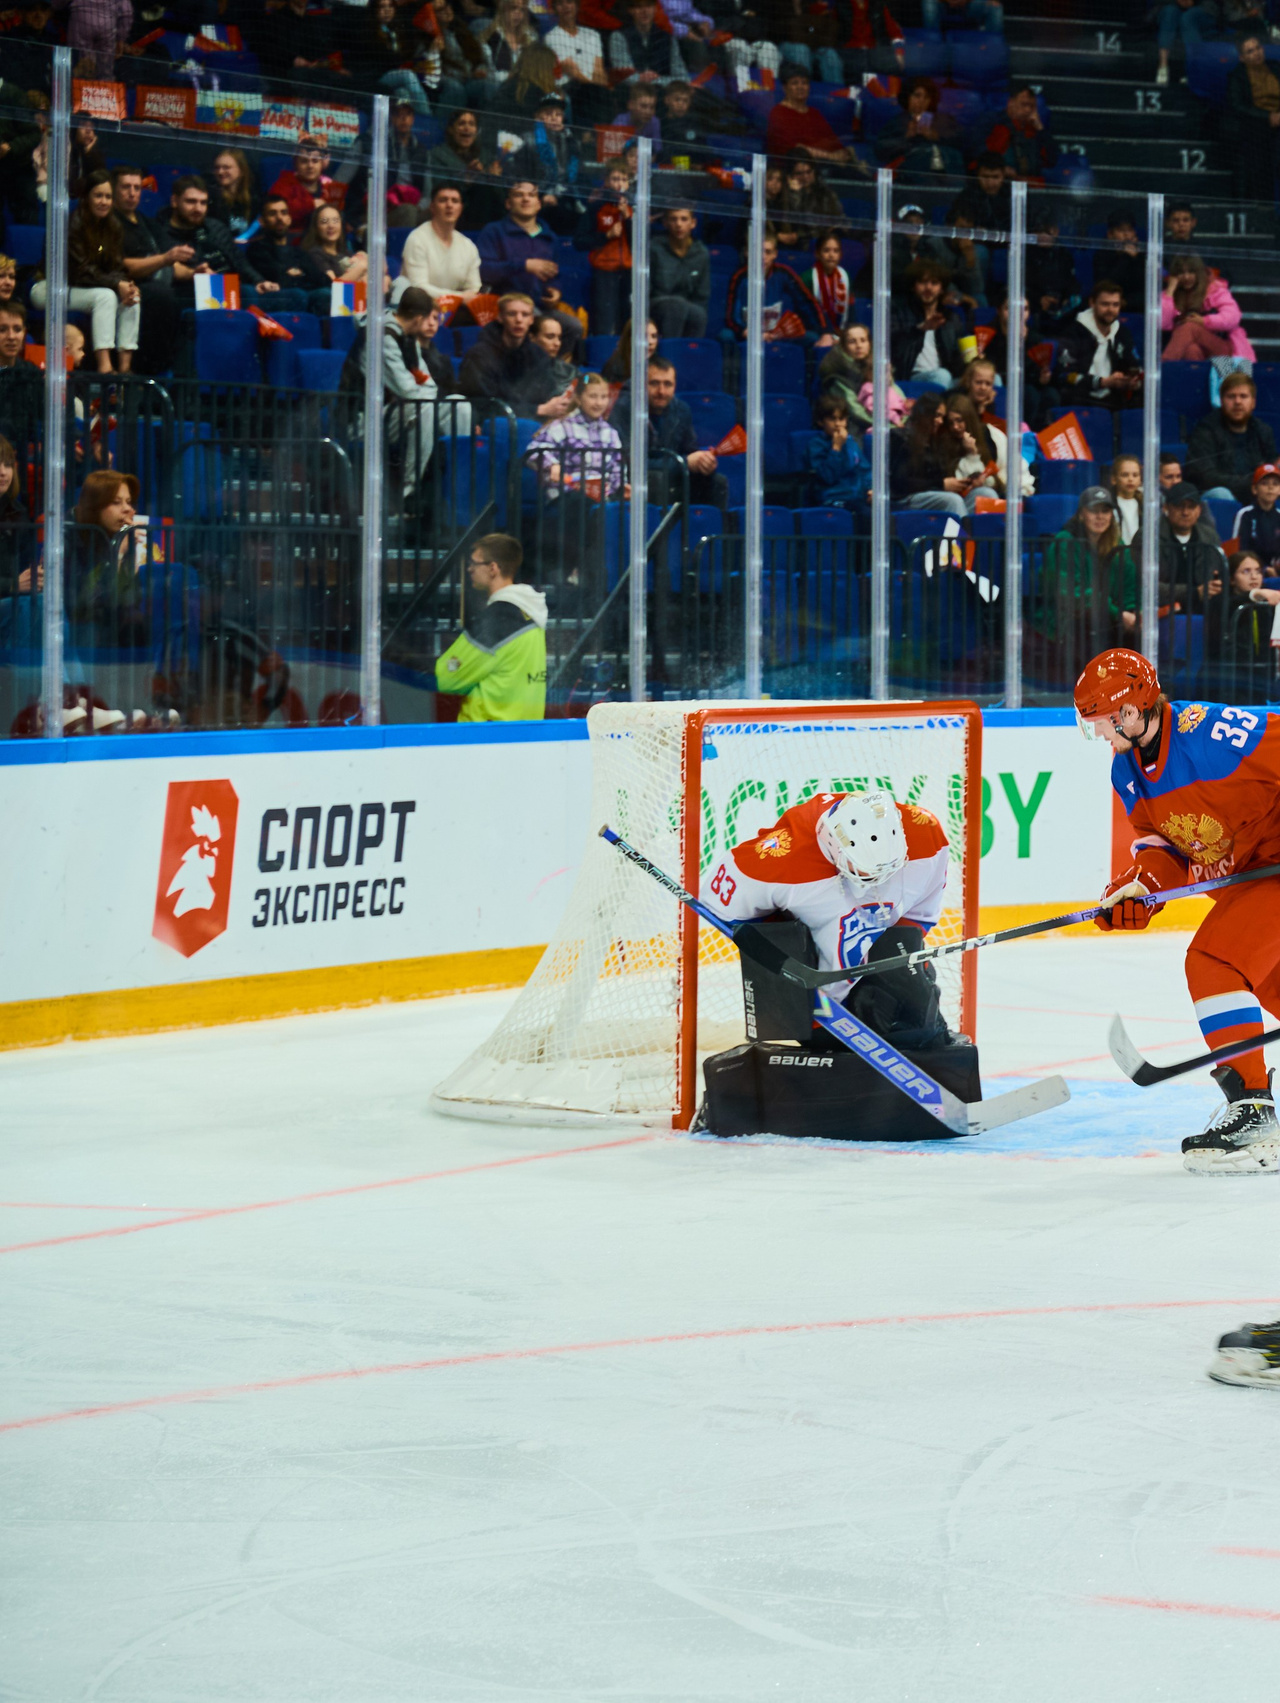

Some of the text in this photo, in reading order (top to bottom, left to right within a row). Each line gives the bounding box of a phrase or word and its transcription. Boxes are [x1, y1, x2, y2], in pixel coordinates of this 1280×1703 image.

[1135, 91, 1161, 112] 13
[1180, 150, 1207, 172] 12
[1227, 213, 1247, 235] 11
[1211, 706, 1259, 748] 33
[258, 800, 416, 873] СПОРТ
[616, 840, 694, 902] SHADOW
[710, 863, 737, 907] 83
[252, 877, 406, 928] ЭКСПРЕСС
[908, 933, 997, 965] CCM
[744, 980, 758, 1039] BAUER
[768, 1055, 834, 1068] BAUER
[830, 1017, 935, 1099] BAUER
